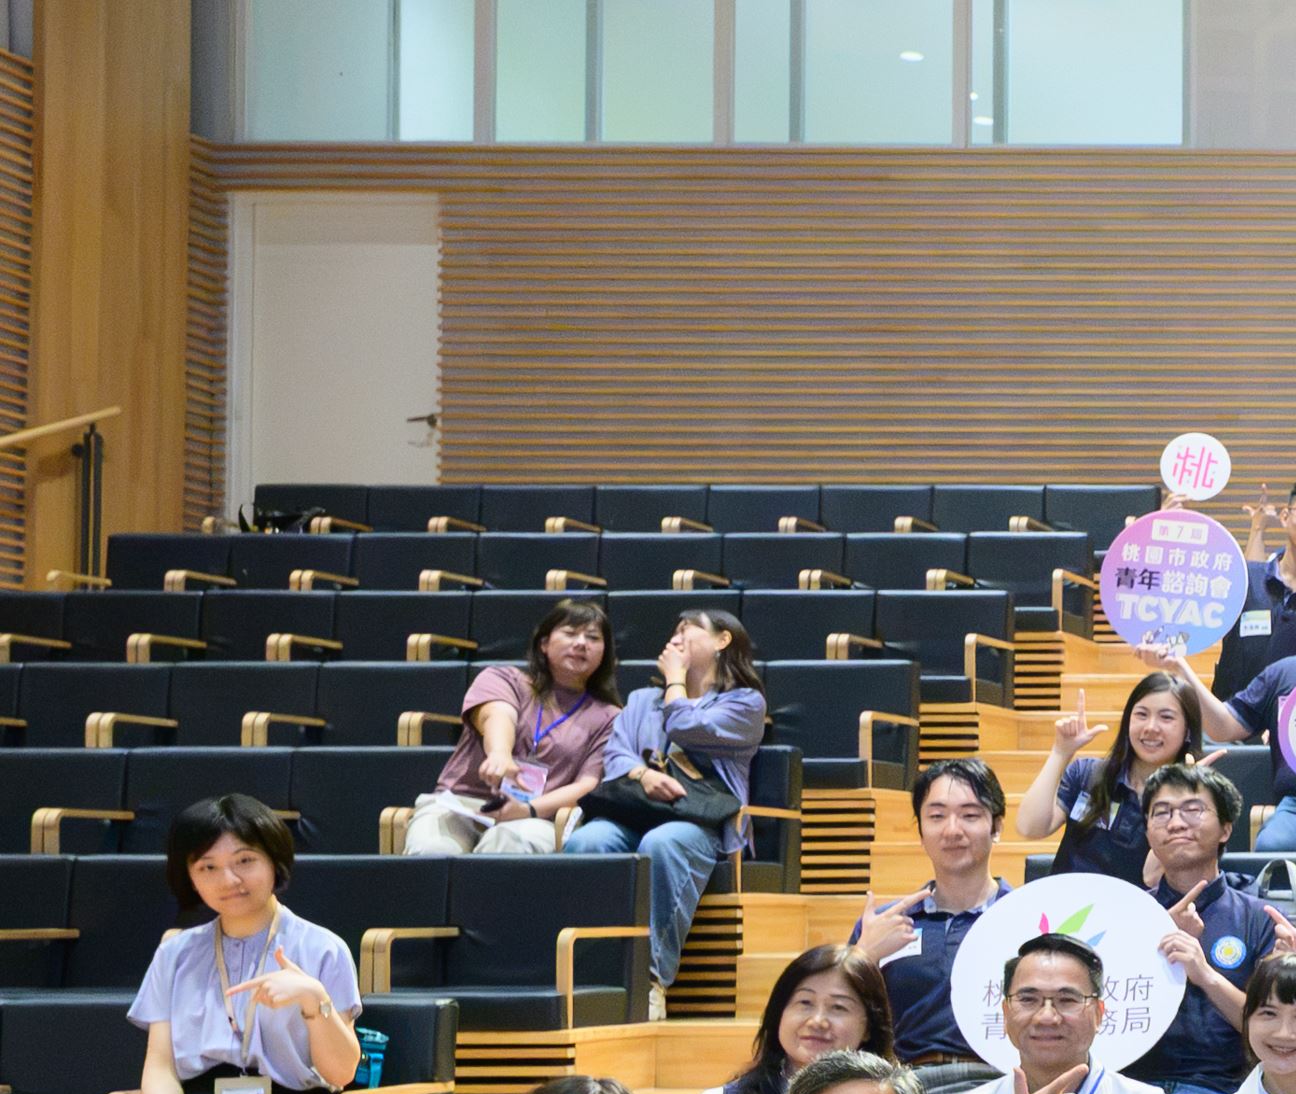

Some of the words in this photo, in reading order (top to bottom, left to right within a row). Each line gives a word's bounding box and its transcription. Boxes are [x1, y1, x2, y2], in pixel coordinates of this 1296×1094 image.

[1121, 543, 1233, 572] 桃園市政府
[1115, 567, 1233, 600] 青年諮詢會
[1115, 592, 1226, 629] TCYAC
